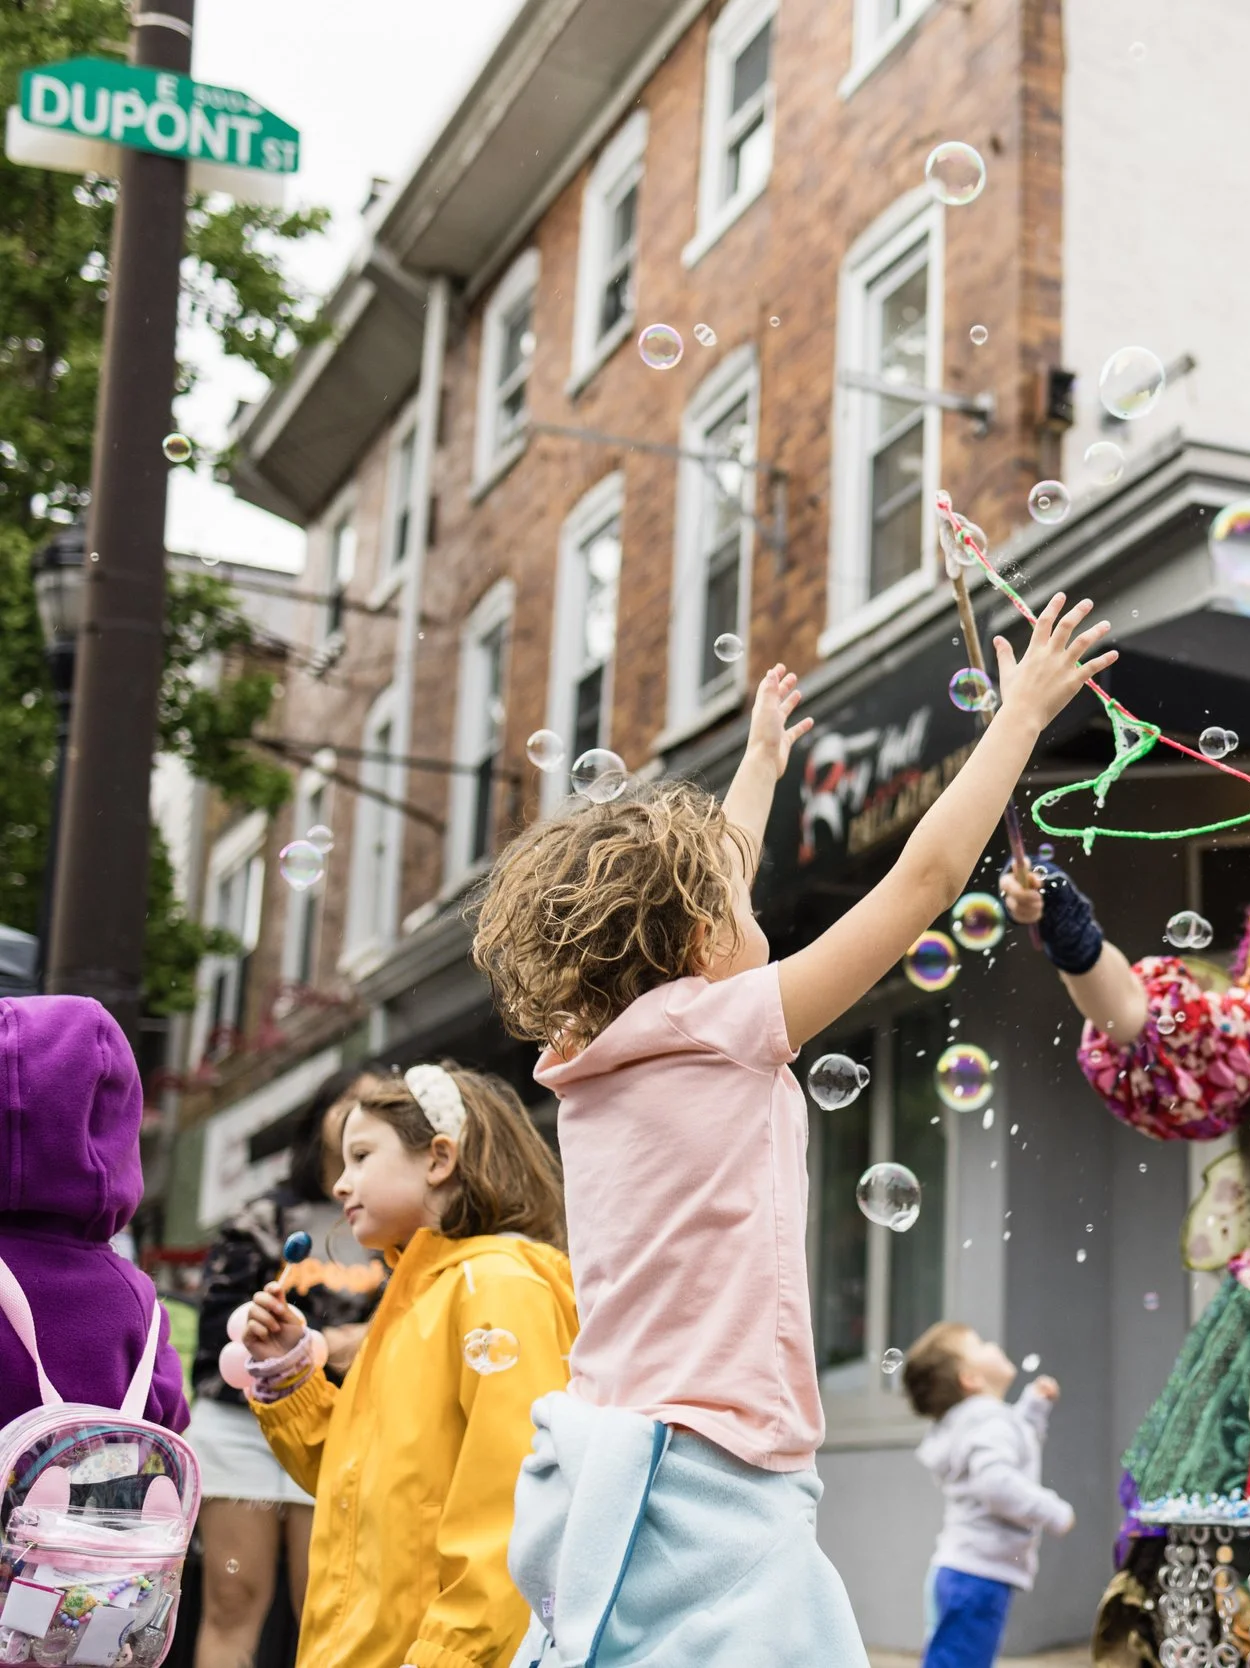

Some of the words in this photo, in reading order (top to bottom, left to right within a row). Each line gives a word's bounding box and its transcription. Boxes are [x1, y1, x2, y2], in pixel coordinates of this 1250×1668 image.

[156, 72, 179, 103] E
[29, 74, 262, 164] DUPONT
[262, 138, 298, 171] ST
